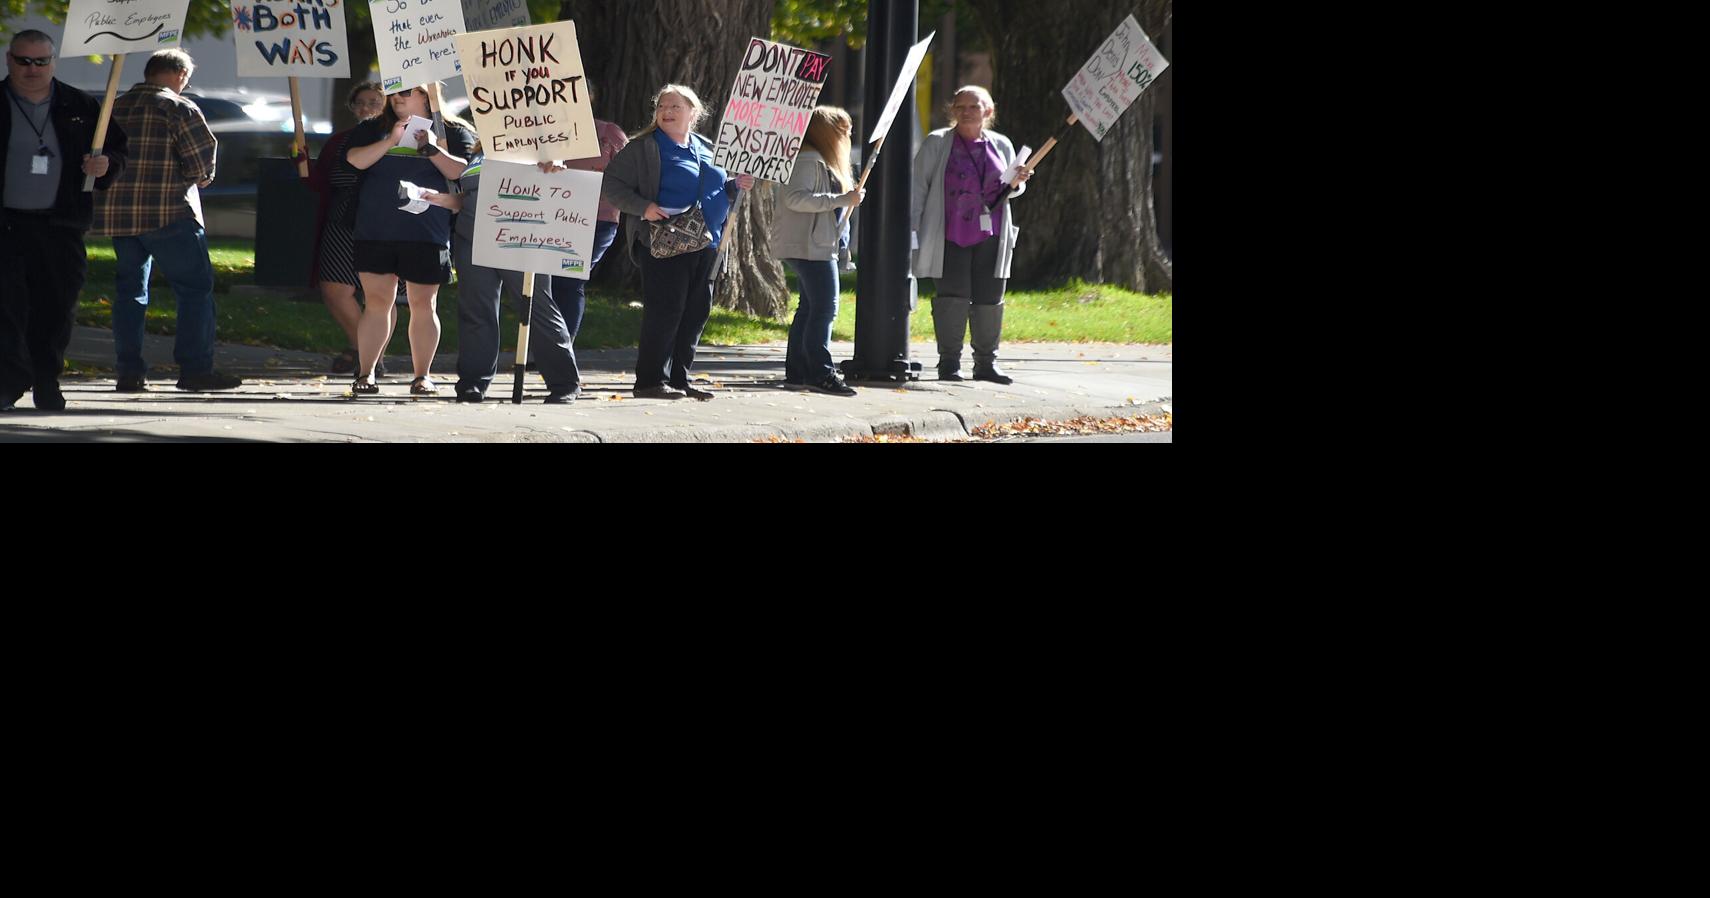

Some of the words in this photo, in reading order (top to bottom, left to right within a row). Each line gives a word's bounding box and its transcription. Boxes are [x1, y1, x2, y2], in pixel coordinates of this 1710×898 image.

[84, 11, 118, 29] Public
[124, 12, 171, 26] Employees
[389, 19, 412, 34] that
[420, 13, 443, 26] even
[255, 37, 338, 67] WAYS
[394, 36, 411, 51] the
[481, 32, 560, 68] HONK
[402, 57, 422, 69] are
[800, 52, 832, 81] PAY
[505, 69, 516, 81] IF
[1127, 60, 1153, 89] 150%
[733, 73, 767, 102] NEW
[766, 77, 820, 110] EMPLOYEE
[503, 114, 556, 130] PUBLIC
[725, 98, 768, 128] MORE
[769, 106, 810, 135] THAN
[718, 122, 801, 160] EXISTING
[714, 147, 792, 184] EMPLOYEES
[550, 187, 572, 199] TO
[487, 204, 545, 223] Support
[554, 208, 590, 227] Public
[495, 227, 573, 249] Employee's
[562, 259, 584, 268] MFPE
